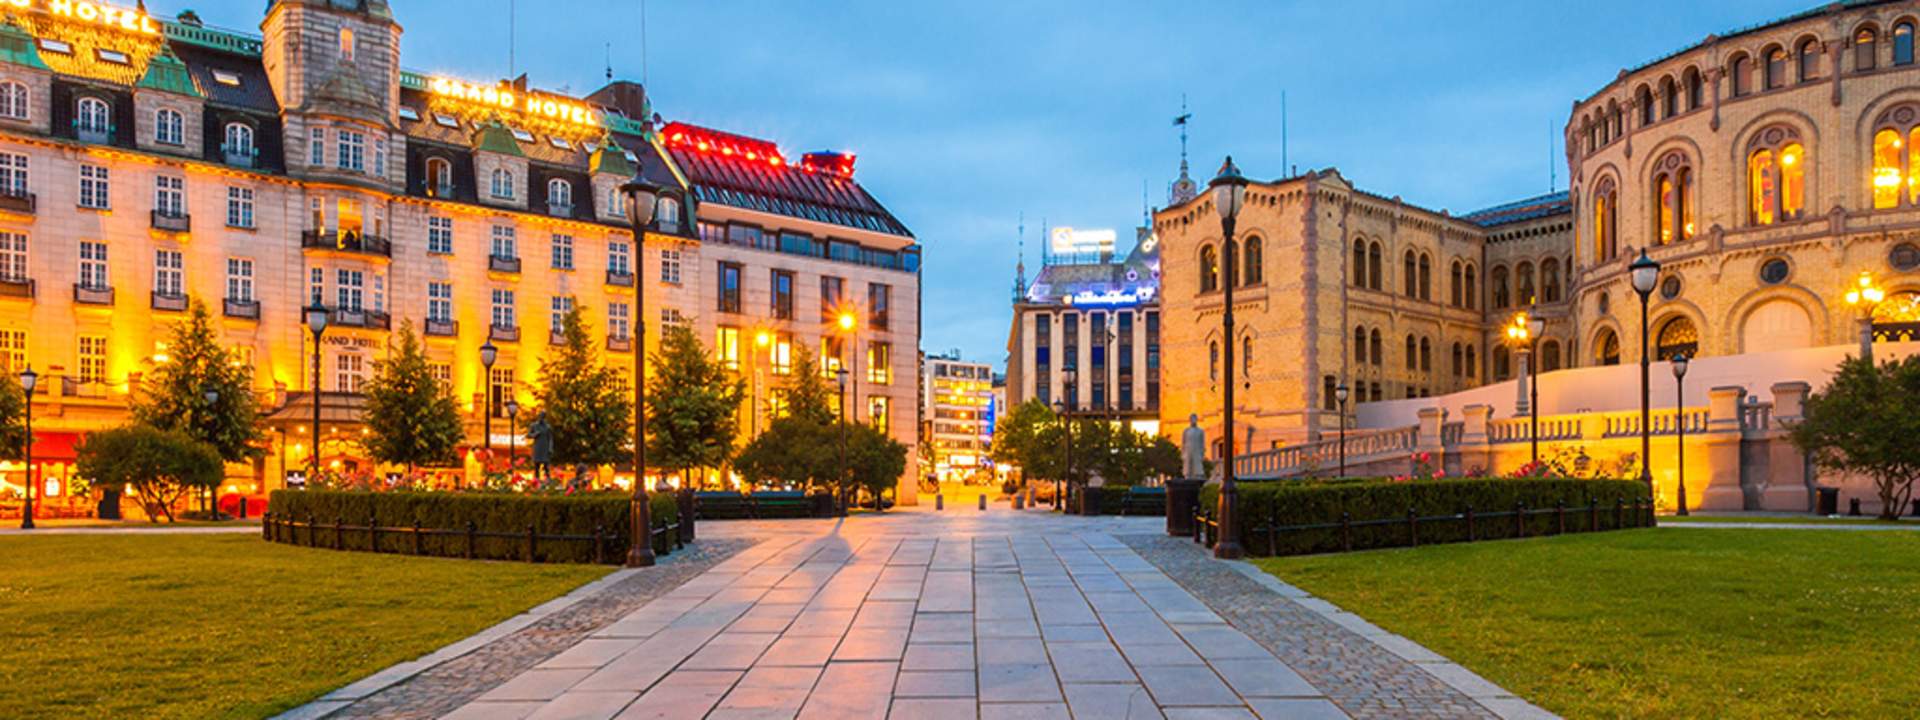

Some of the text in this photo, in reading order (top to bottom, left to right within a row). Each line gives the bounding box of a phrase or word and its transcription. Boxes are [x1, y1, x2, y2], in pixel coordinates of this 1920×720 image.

[50, 0, 156, 33] HOTEL
[433, 77, 596, 125] GRAND HOTEL
[314, 336, 382, 349] RAND HOTEL
